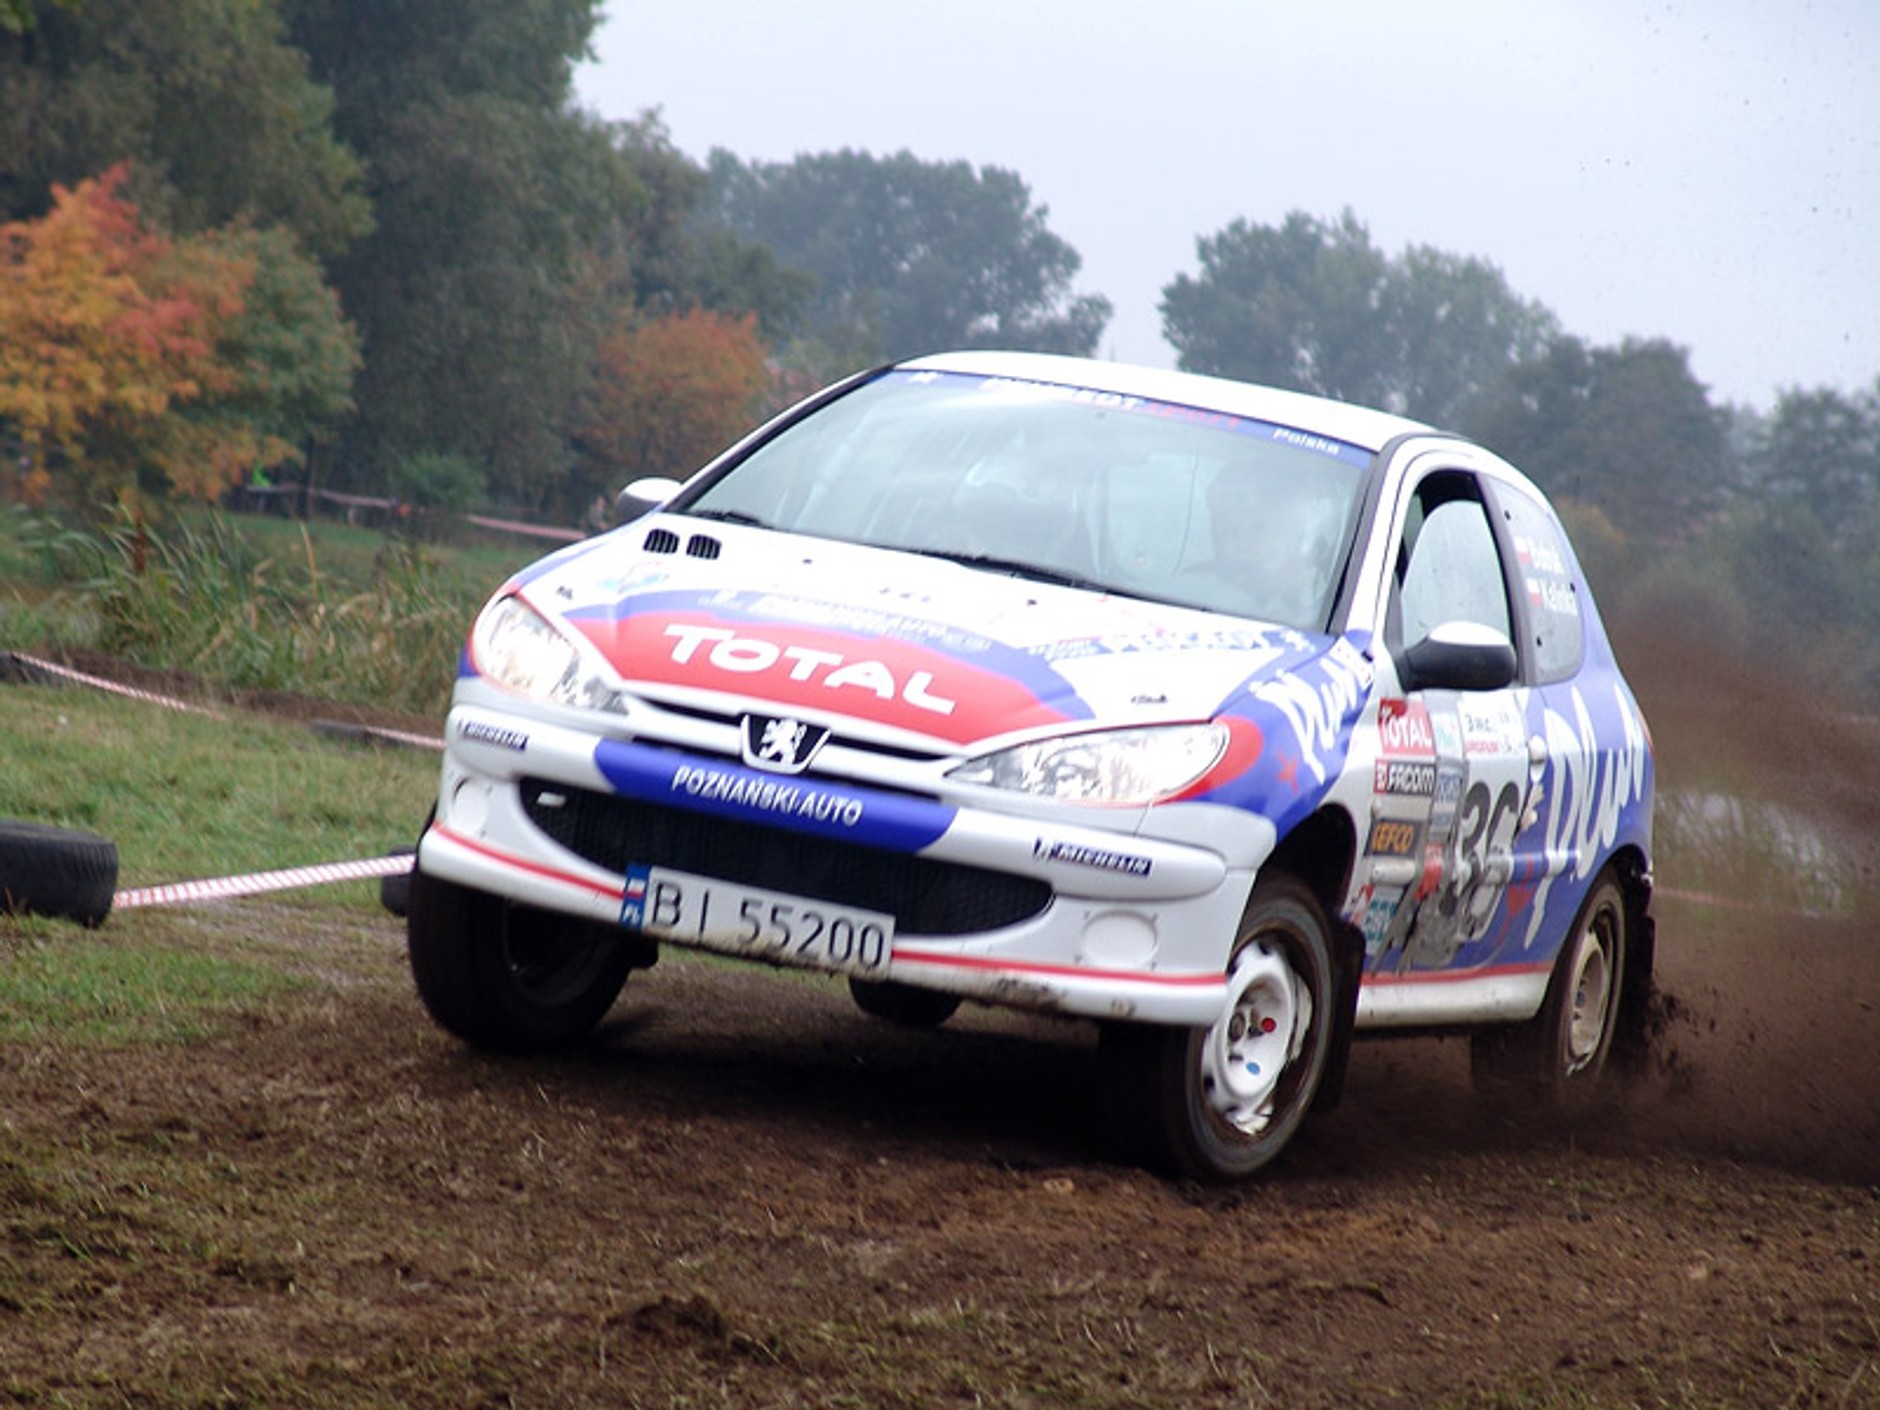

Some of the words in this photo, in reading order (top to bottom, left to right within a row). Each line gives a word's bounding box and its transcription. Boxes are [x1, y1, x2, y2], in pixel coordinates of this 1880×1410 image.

[664, 625, 955, 715] TOTAL
[1381, 704, 1433, 750] TOTAL
[671, 765, 799, 813] POZNAŃSKI
[798, 790, 863, 827] AUTO
[738, 900, 886, 970] 55200
